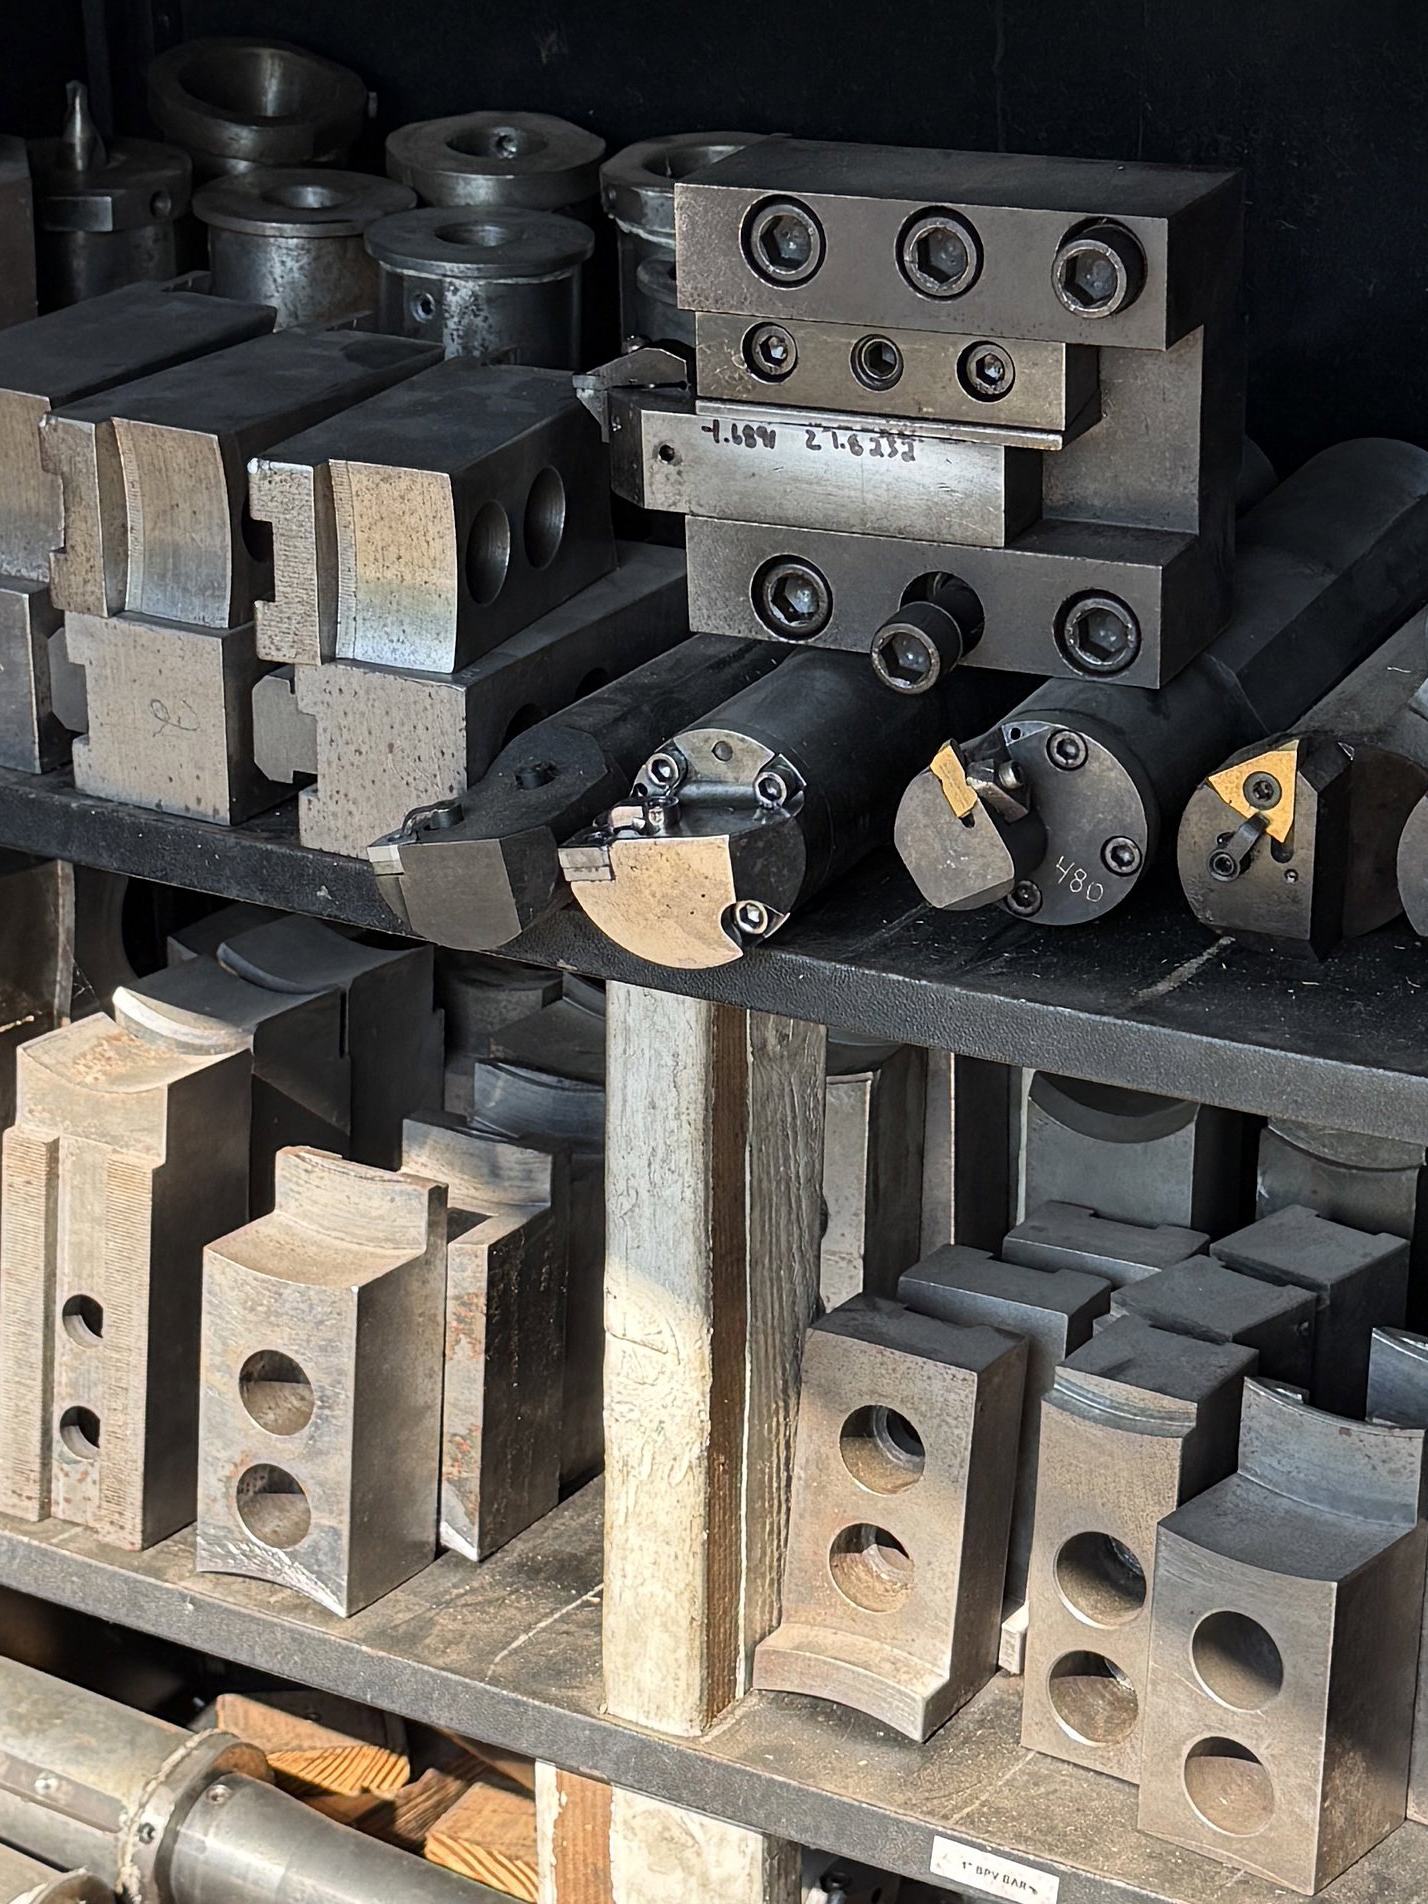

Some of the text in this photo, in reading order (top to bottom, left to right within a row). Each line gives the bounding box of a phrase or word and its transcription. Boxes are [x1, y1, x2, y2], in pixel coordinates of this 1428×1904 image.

[1055, 855, 1104, 902] 480
[975, 1865, 1000, 1881] BPV
[1002, 1873, 1027, 1891] BAR
